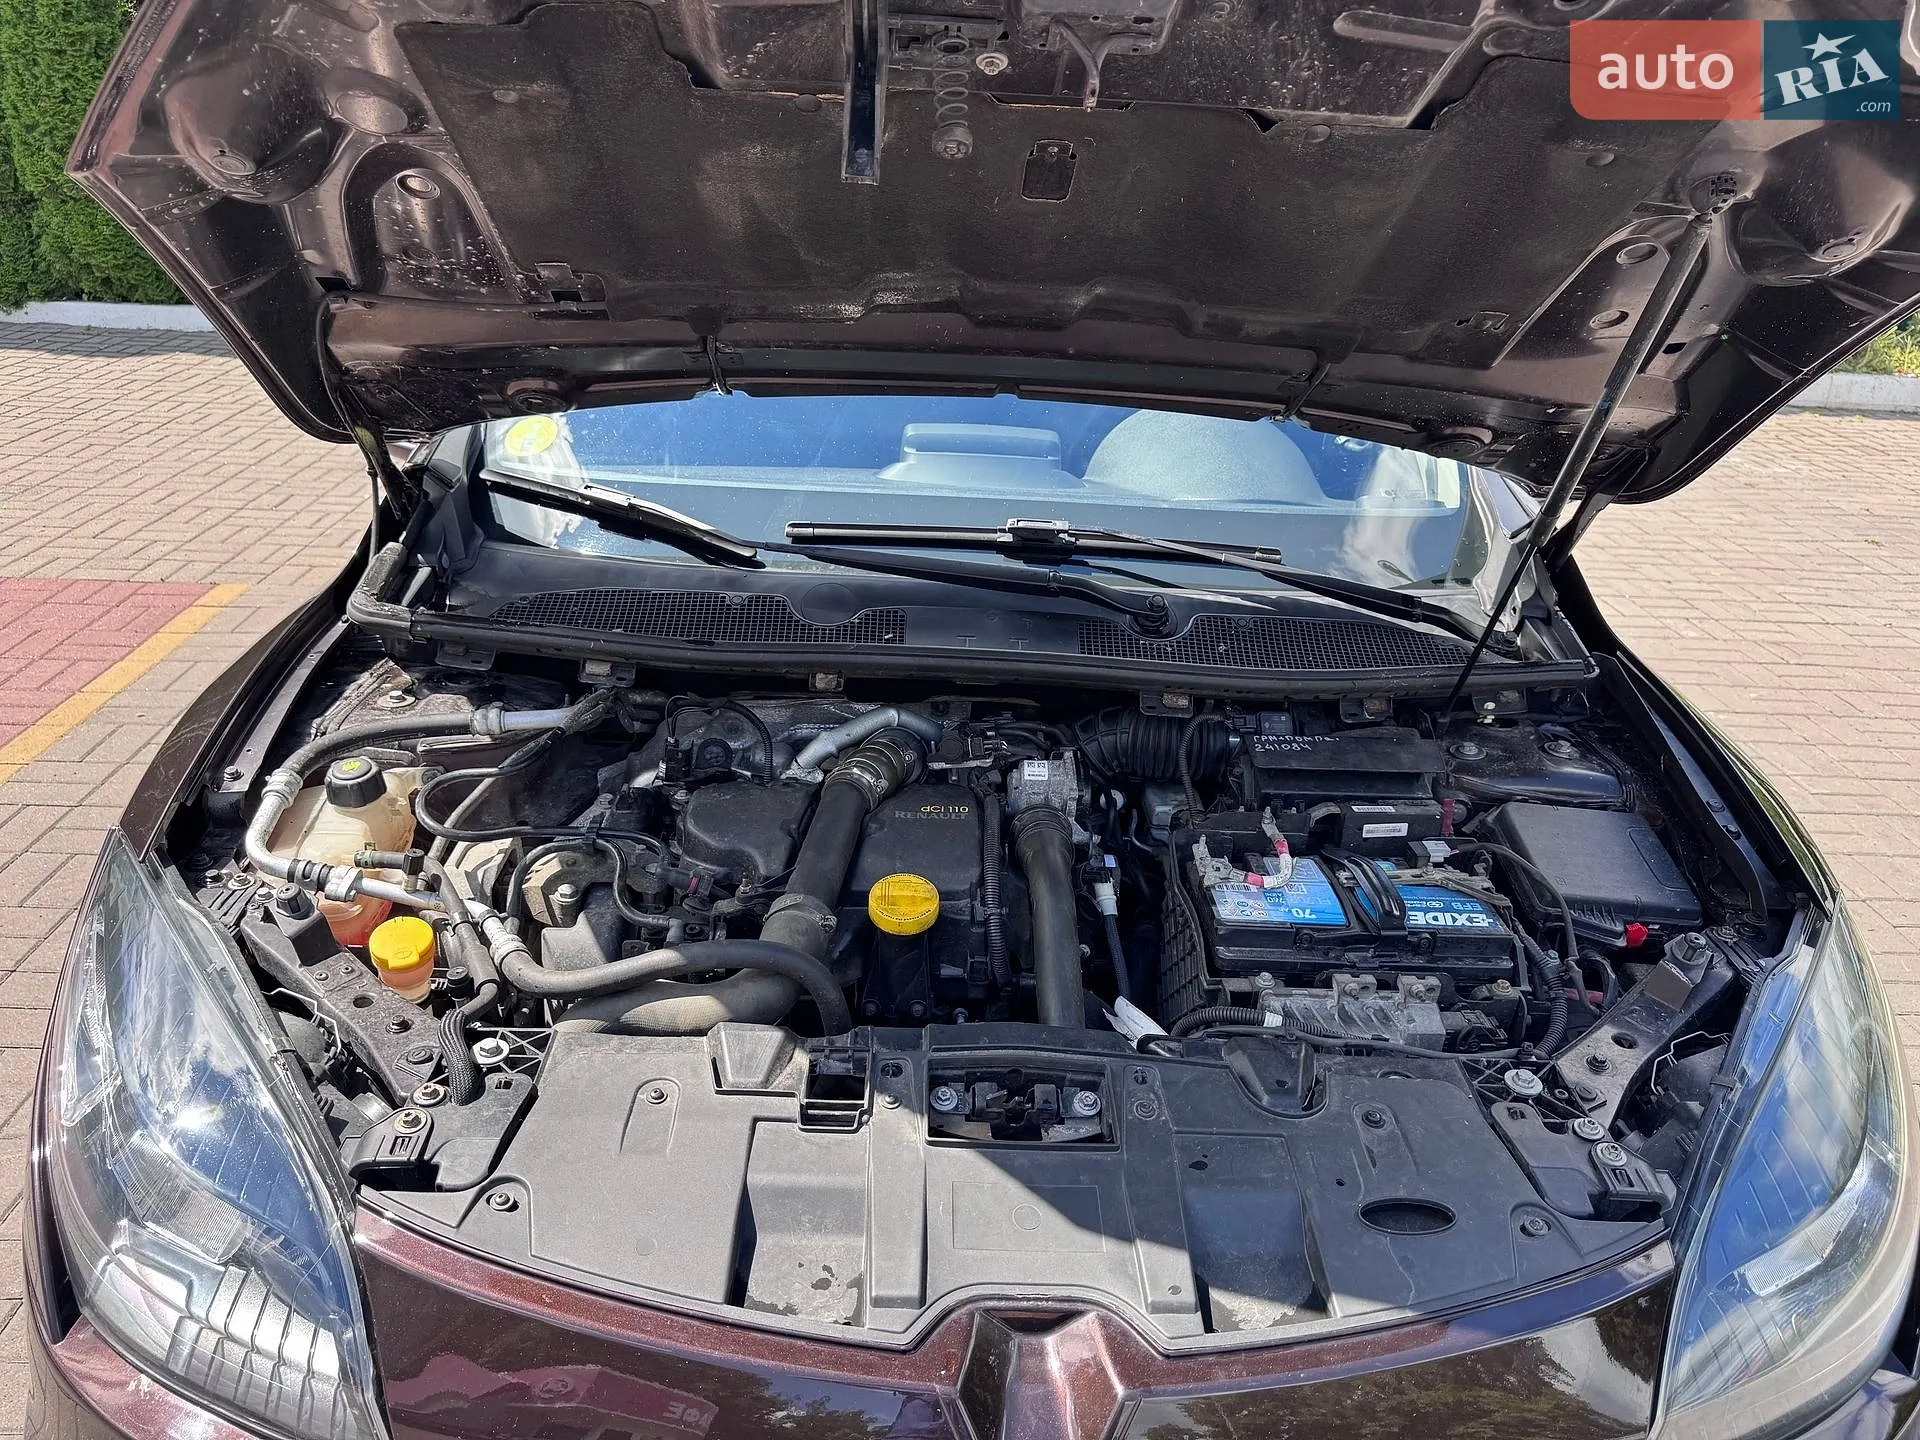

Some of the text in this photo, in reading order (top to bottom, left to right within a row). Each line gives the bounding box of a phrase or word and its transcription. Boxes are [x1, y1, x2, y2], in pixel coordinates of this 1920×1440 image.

[896, 811, 968, 819] RENAULT
[1451, 902, 1483, 911] EFB
[1291, 908, 1316, 918] 70
[1407, 912, 1493, 927] EXIDE
